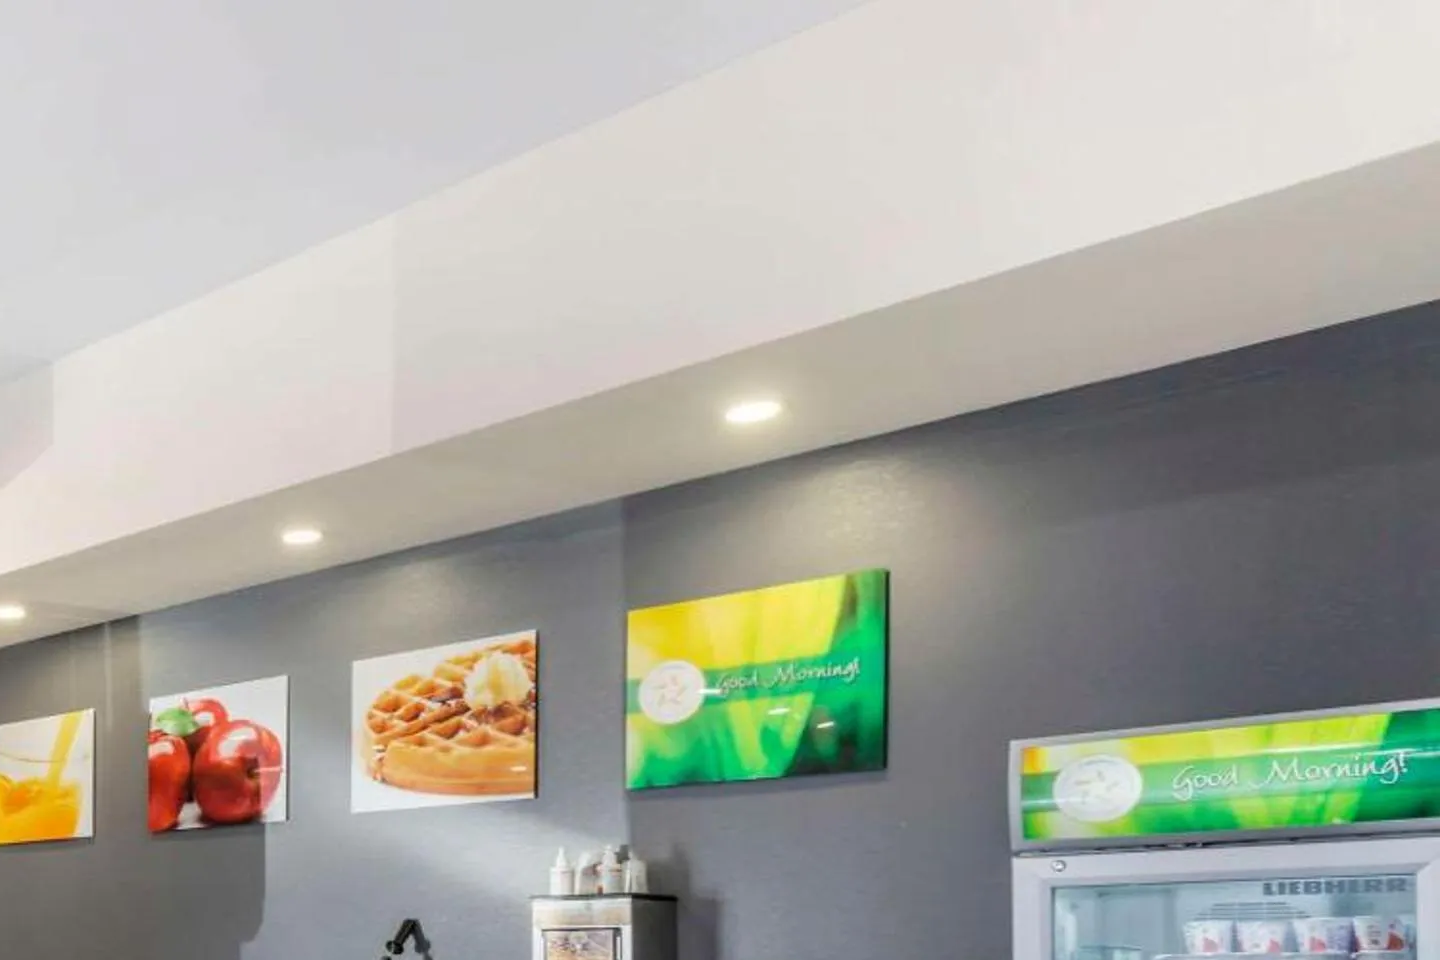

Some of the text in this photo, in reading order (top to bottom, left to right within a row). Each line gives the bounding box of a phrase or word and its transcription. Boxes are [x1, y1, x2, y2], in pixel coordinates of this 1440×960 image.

[716, 656, 861, 695] Good Morning!
[1172, 750, 1408, 801] Good Morning!
[1262, 877, 1408, 896] LIEBHERR
